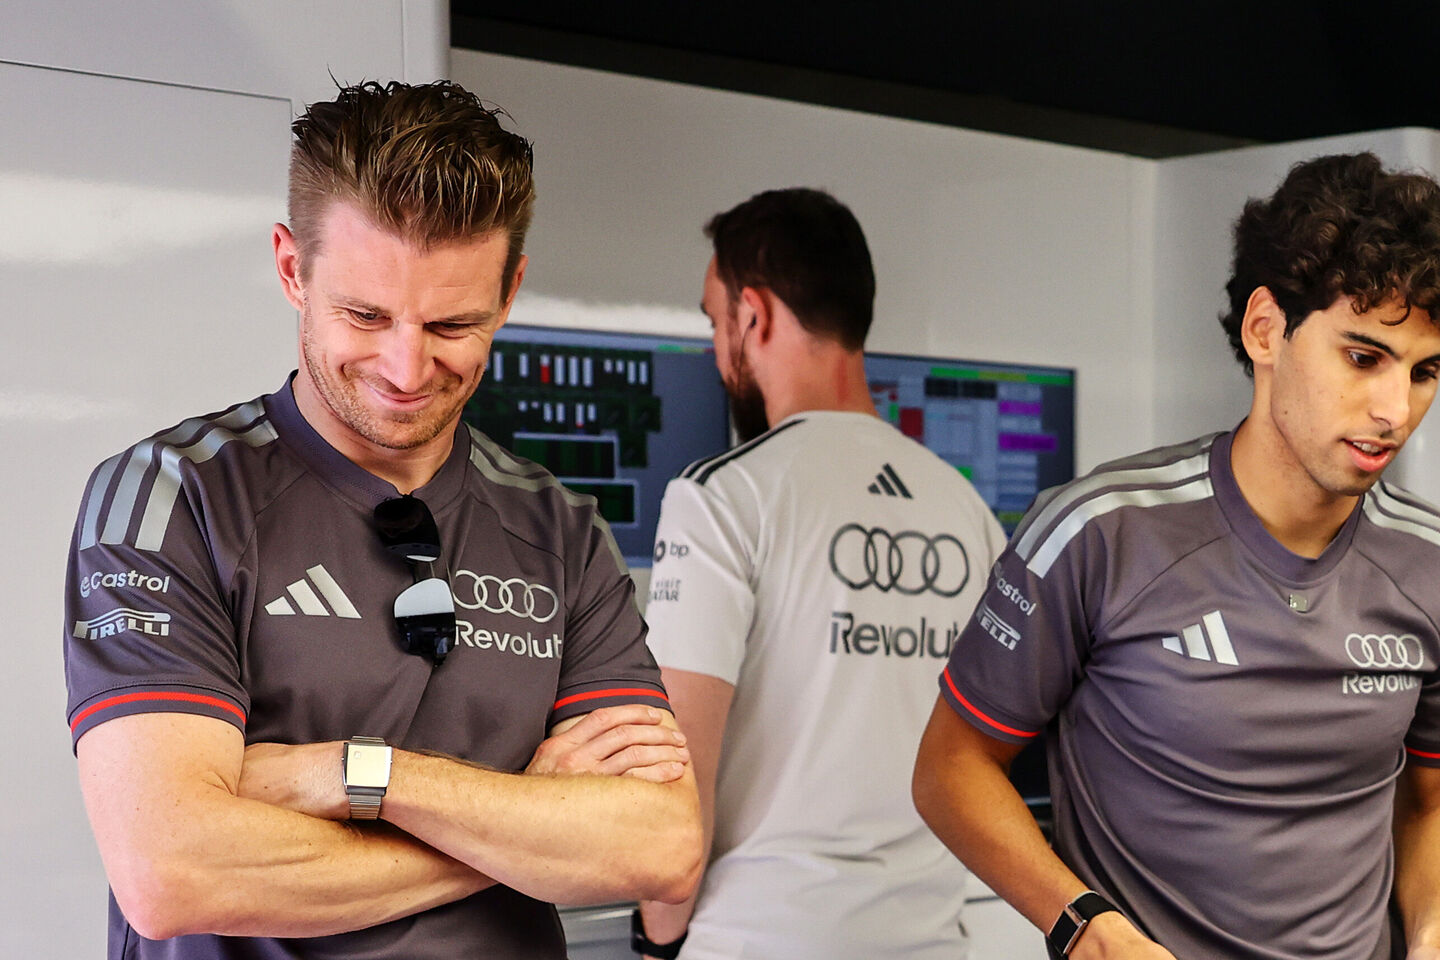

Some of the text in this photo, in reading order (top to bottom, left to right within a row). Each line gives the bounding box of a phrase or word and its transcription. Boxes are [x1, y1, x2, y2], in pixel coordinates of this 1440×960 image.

[670, 541, 689, 560] bp
[90, 569, 170, 593] Castrol
[73, 607, 171, 640] PIRELLI
[455, 620, 562, 659] Revolut
